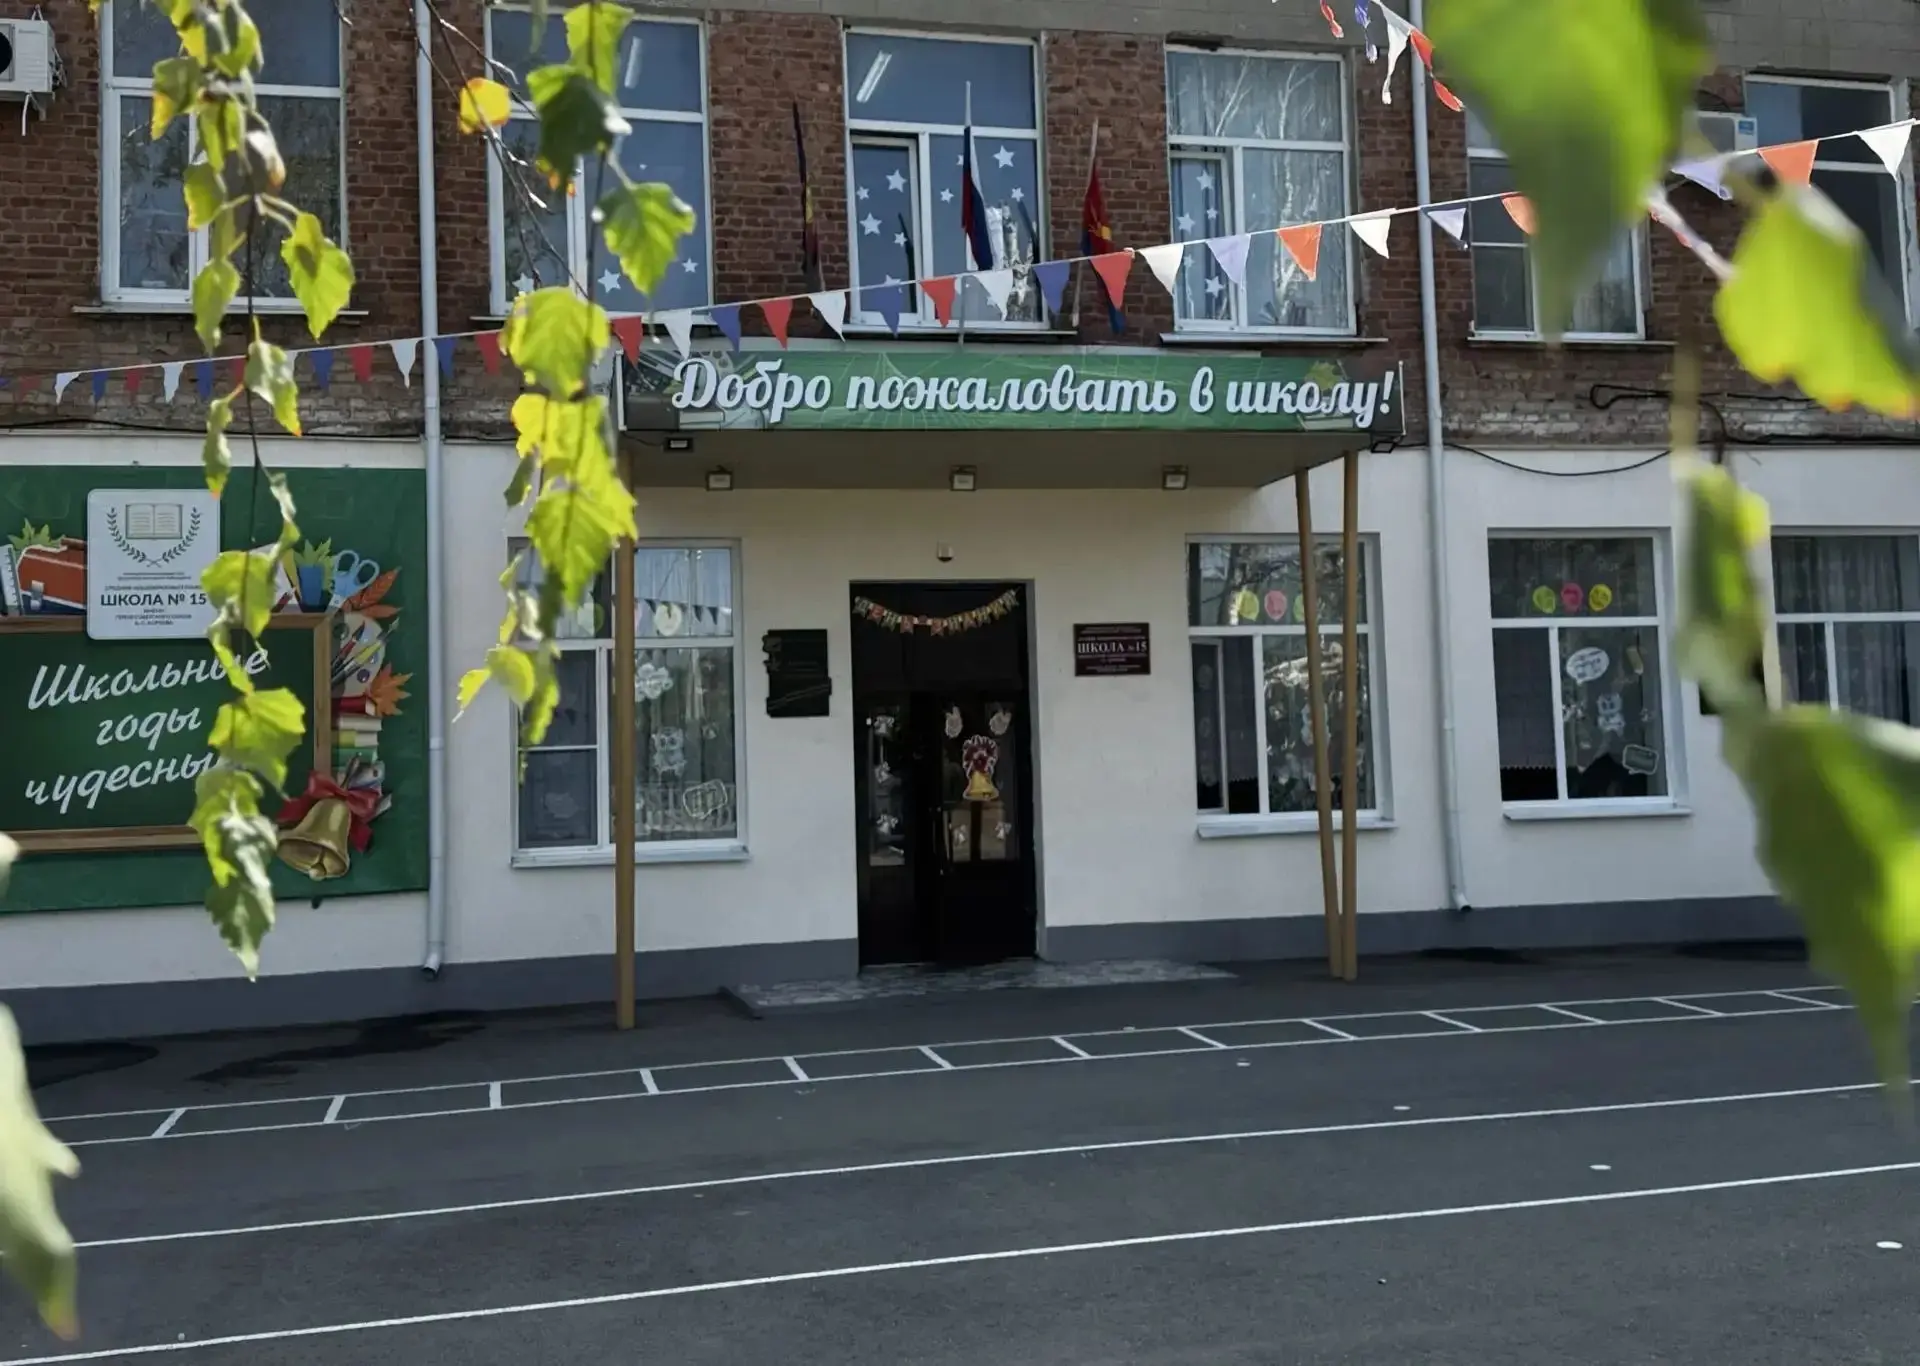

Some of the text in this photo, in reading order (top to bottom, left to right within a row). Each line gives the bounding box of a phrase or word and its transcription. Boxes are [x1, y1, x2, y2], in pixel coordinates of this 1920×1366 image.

[672, 357, 1395, 429] Добро пожаловать в школу!
[101, 593, 164, 606] ШКОЛА
[190, 593, 207, 605] 15
[1077, 642, 1125, 653] ШКОЛА
[96, 707, 202, 751] годы
[25, 752, 214, 814] чудесны
